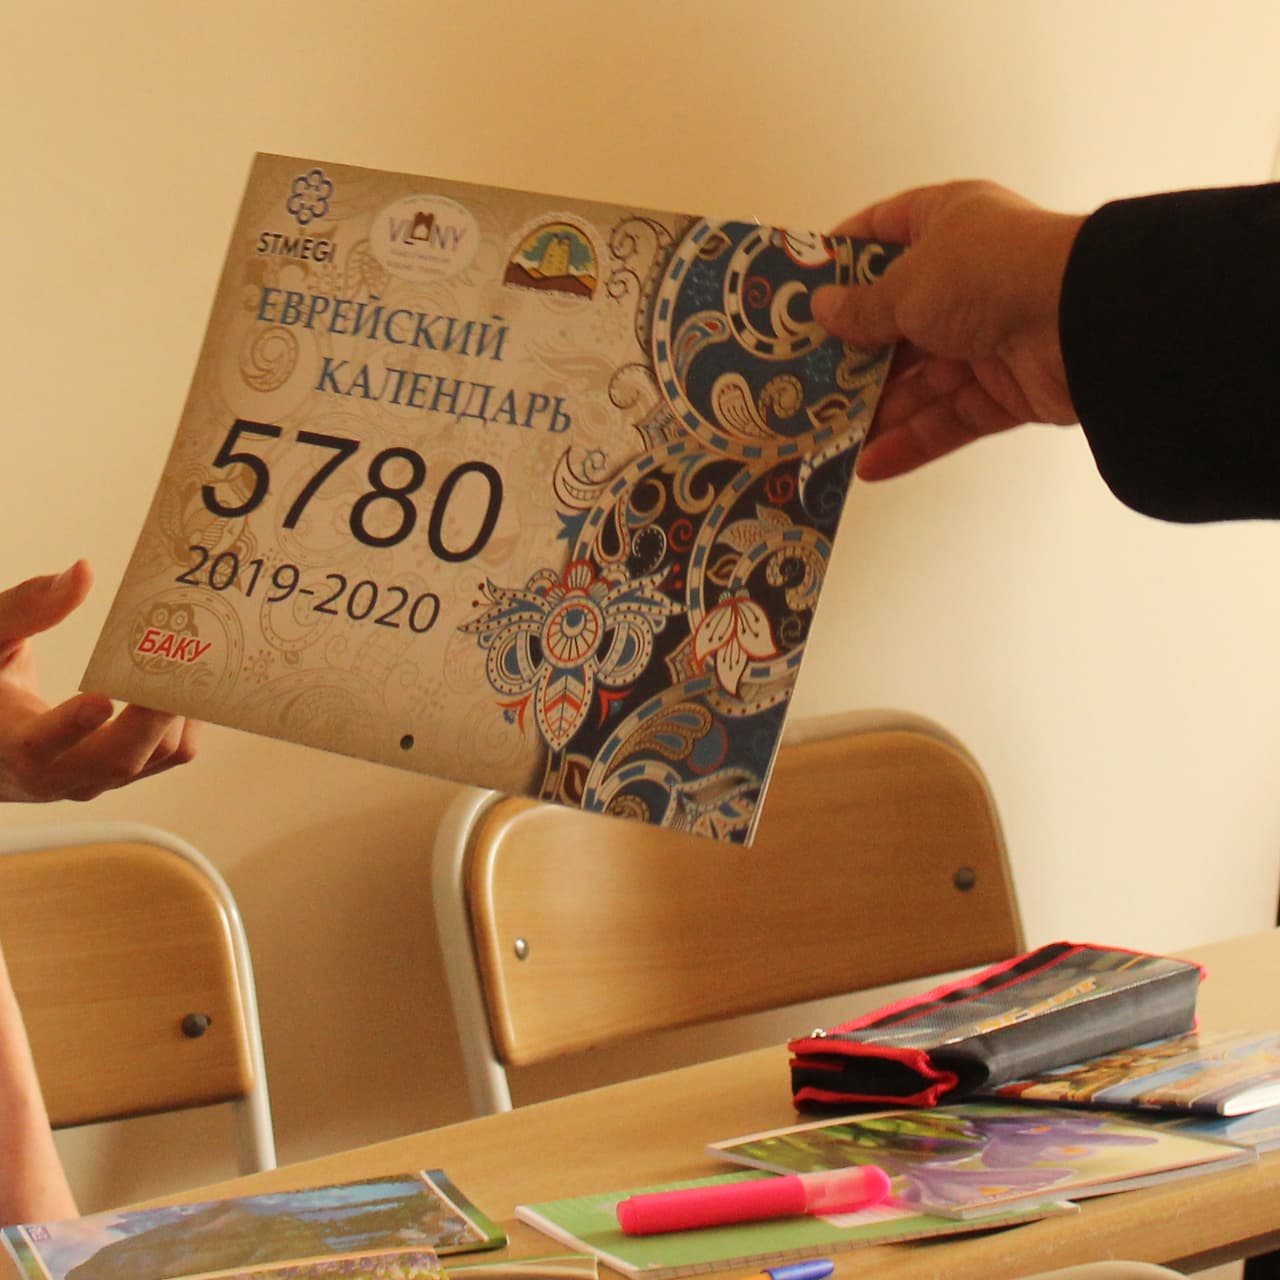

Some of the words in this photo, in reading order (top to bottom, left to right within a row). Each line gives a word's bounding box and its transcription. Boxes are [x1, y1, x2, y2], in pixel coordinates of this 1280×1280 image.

[256, 231, 336, 265] STMEGI
[257, 287, 511, 361] ЕВРЕЙСКИЙ
[315, 357, 573, 434] КАЛЕНДАРЬ
[201, 418, 504, 563] 5780
[175, 544, 441, 634] 2019-2020
[137, 629, 212, 663] БАКУ
